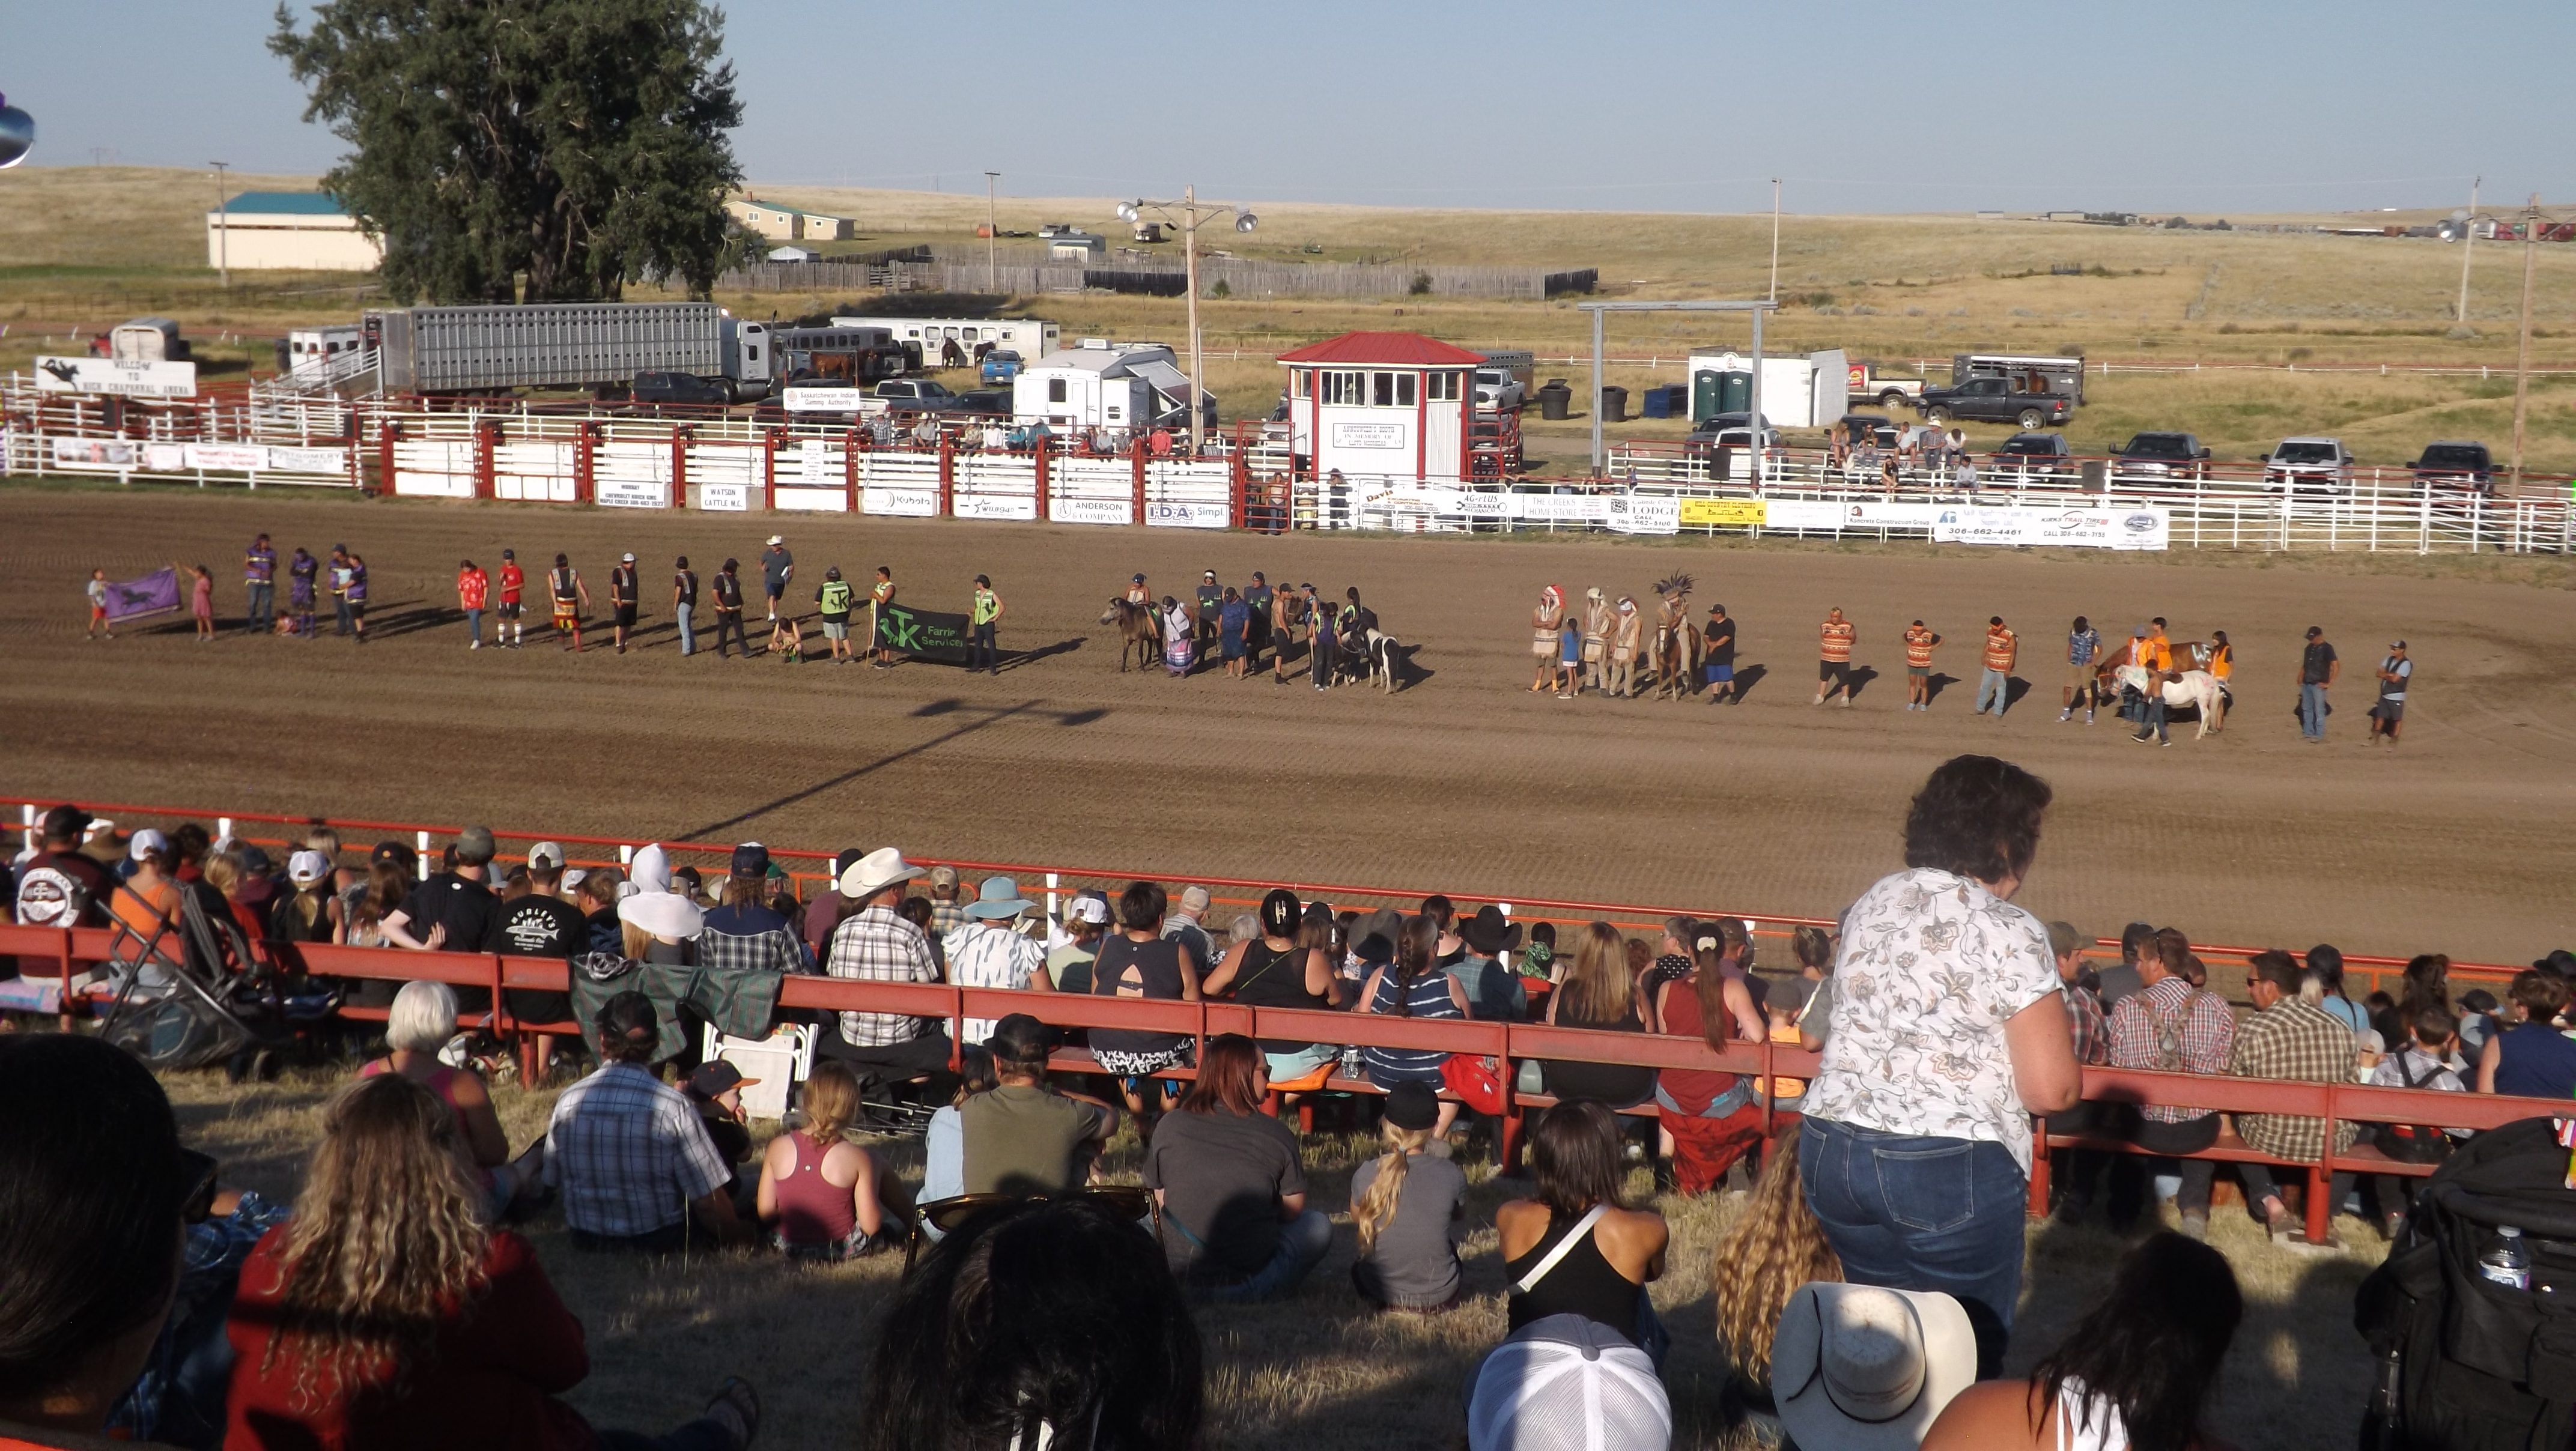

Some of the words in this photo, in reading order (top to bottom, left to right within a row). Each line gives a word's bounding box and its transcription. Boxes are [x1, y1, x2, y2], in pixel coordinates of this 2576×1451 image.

[897, 495, 931, 504] Kubota
[1365, 489, 1394, 502] Davis
[1075, 502, 1122, 510] ANDERSON
[1533, 497, 1546, 506] THE
[1548, 498, 1576, 506] CREEKS
[1554, 508, 1577, 516] STORE
[1633, 506, 1678, 515] LODGE
[1080, 512, 1124, 521] COMPANY
[831, 589, 849, 609] TK
[889, 608, 923, 650] TK
[928, 625, 959, 637] Farrie
